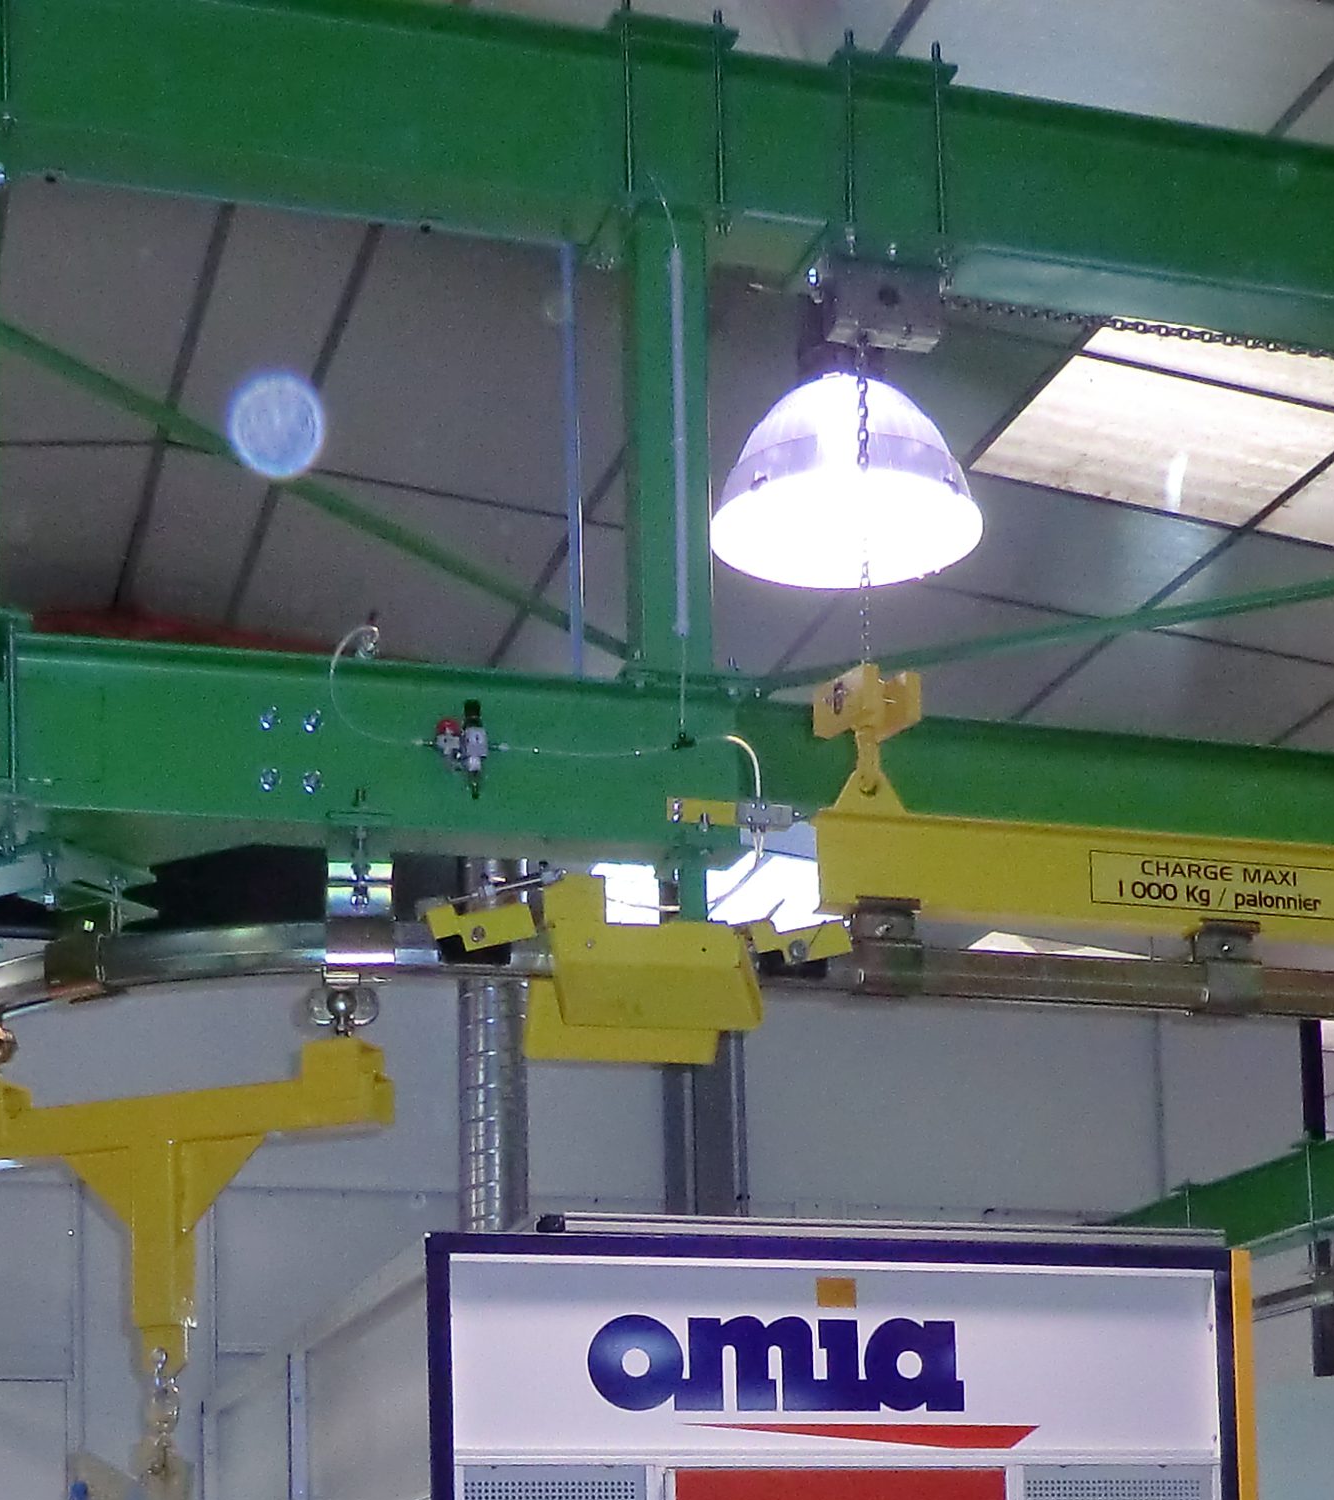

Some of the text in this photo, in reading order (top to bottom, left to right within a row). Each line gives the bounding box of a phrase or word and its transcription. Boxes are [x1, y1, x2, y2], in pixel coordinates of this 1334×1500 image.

[1141, 859, 1297, 887] CHARGE MAXI
[1185, 884, 1211, 907] Kg
[1234, 890, 1322, 912] palonnier
[587, 1277, 965, 1413] omia
